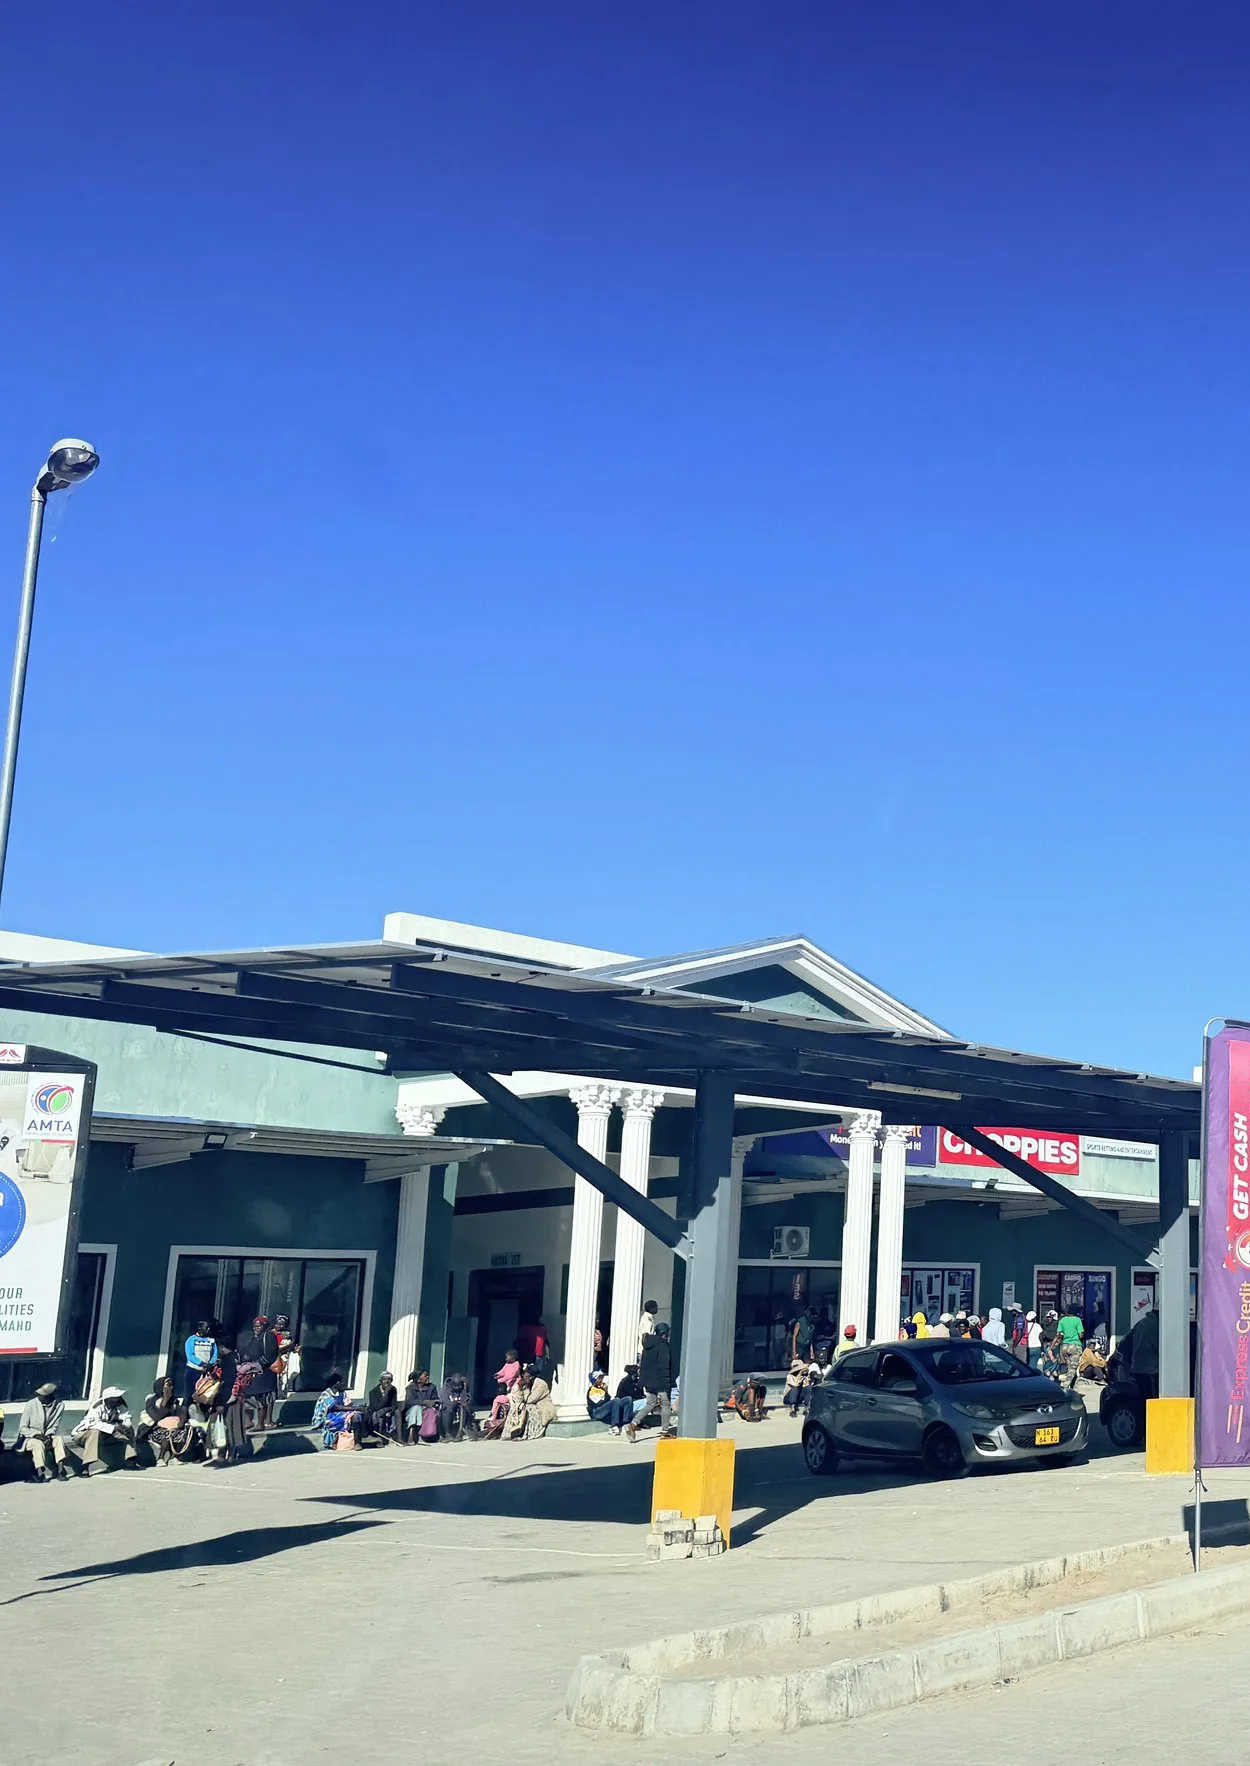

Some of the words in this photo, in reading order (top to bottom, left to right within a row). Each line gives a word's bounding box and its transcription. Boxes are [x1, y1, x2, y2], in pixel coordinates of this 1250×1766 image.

[27, 1119, 73, 1132] AMTA
[830, 1133, 852, 1144] Mone
[1233, 1112, 1249, 1173] CASH
[1233, 1174, 1249, 1220] GET
[1230, 1335, 1249, 1401] Express
